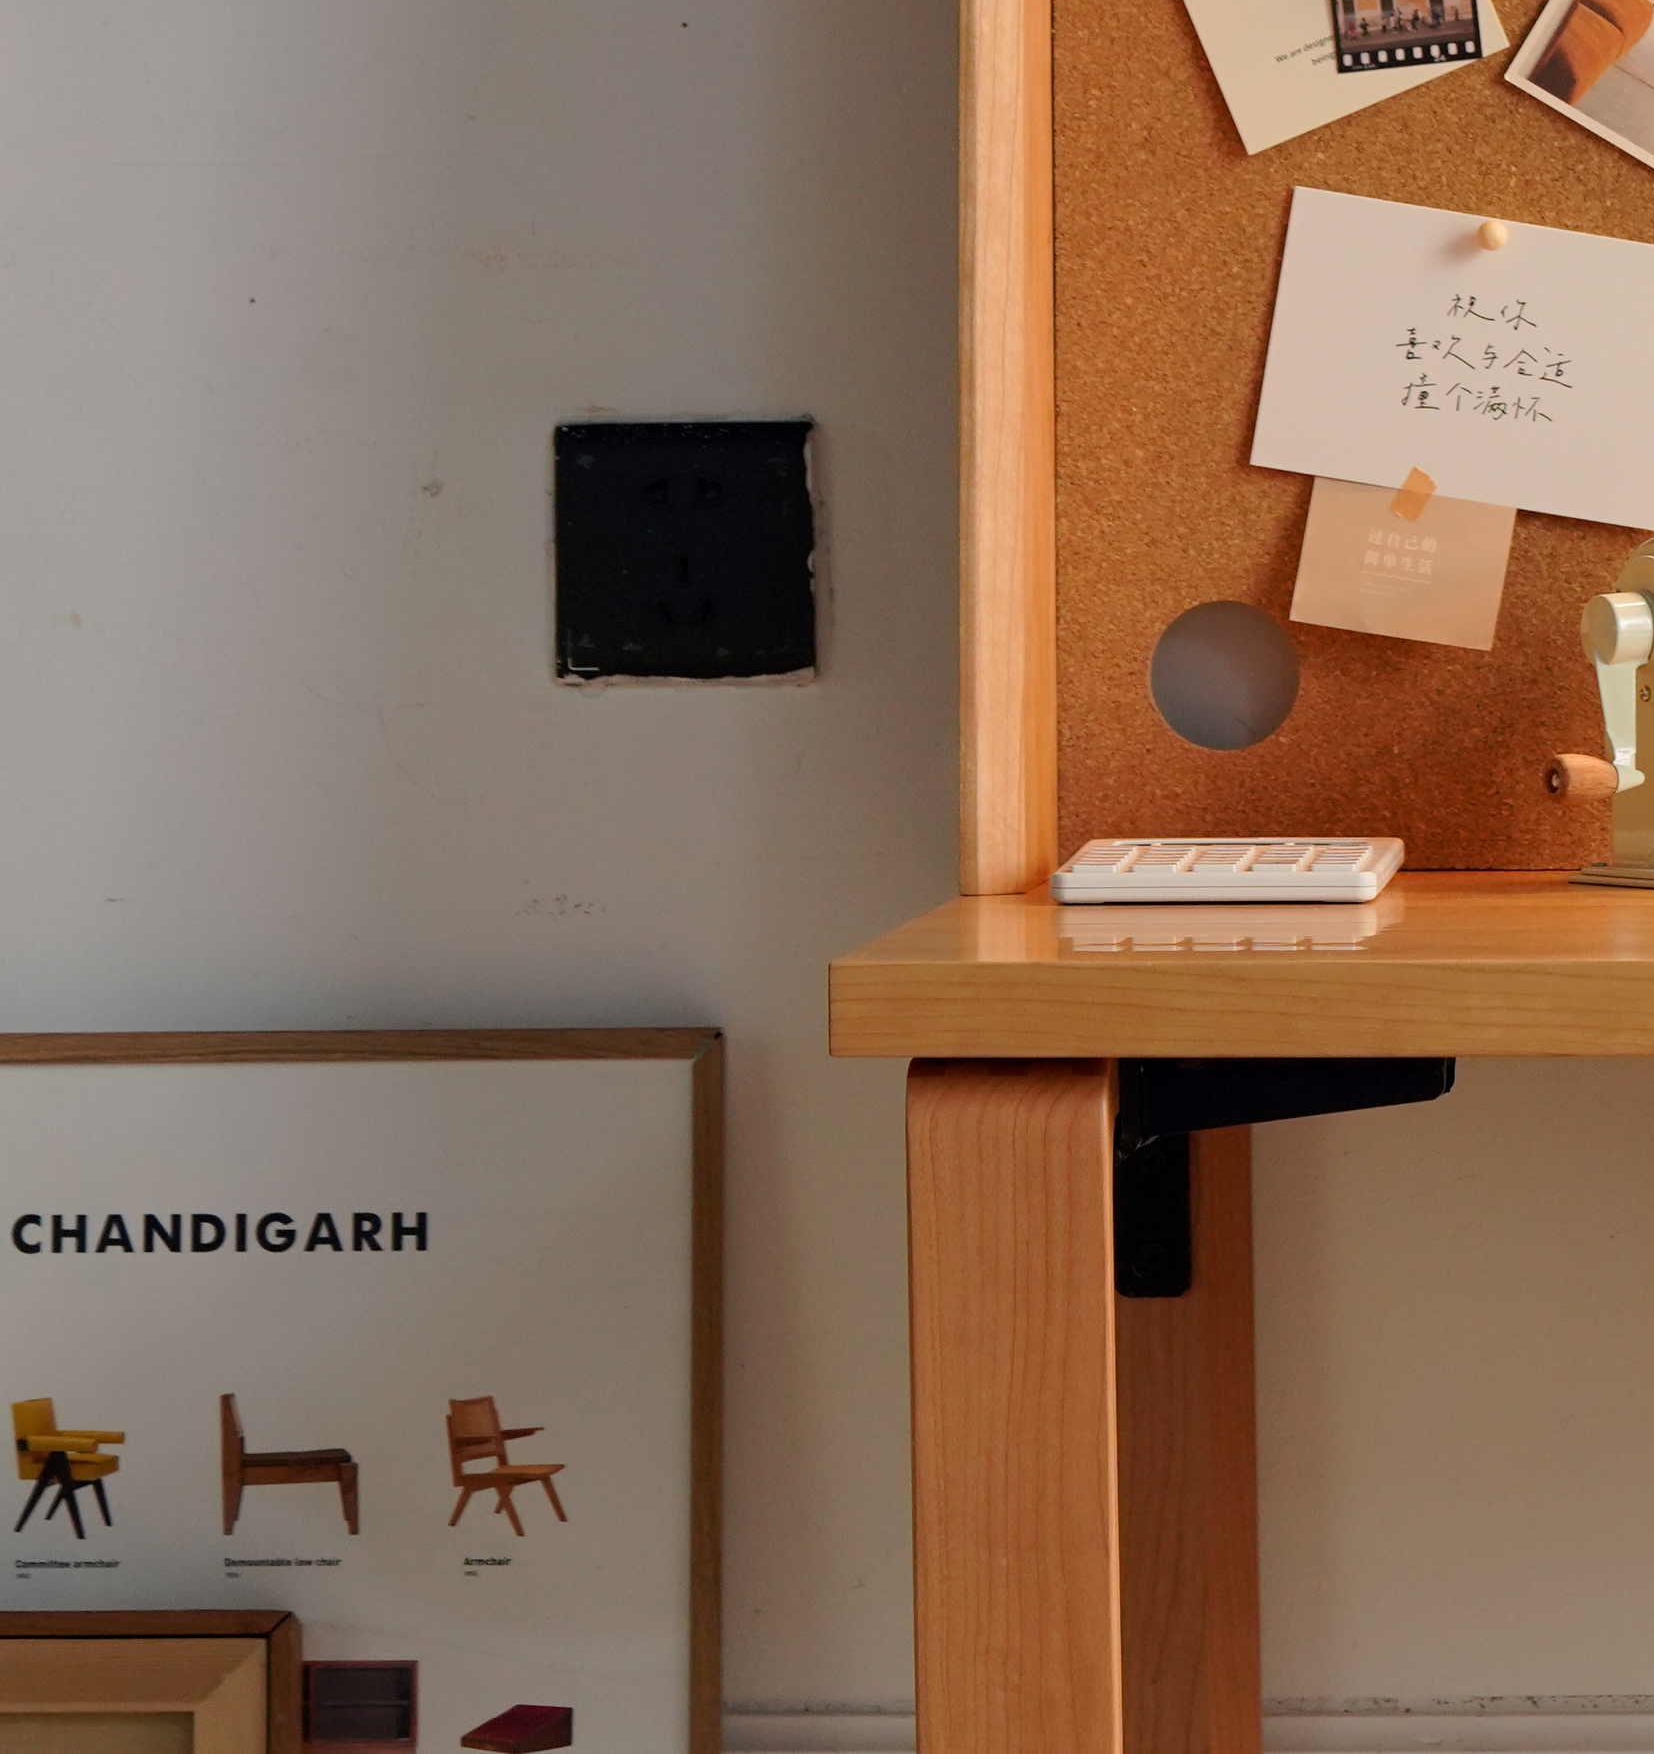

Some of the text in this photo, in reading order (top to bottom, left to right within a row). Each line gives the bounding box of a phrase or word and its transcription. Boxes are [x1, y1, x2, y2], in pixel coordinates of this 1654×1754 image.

[1275, 53, 1288, 64] We
[1289, 48, 1302, 58] are
[1447, 293, 1537, 330] 祝你
[1396, 328, 1573, 389] 喜欢与合适
[1401, 372, 1553, 422] 撞个满怀
[12, 1213, 429, 1254] CHANDIGARH
